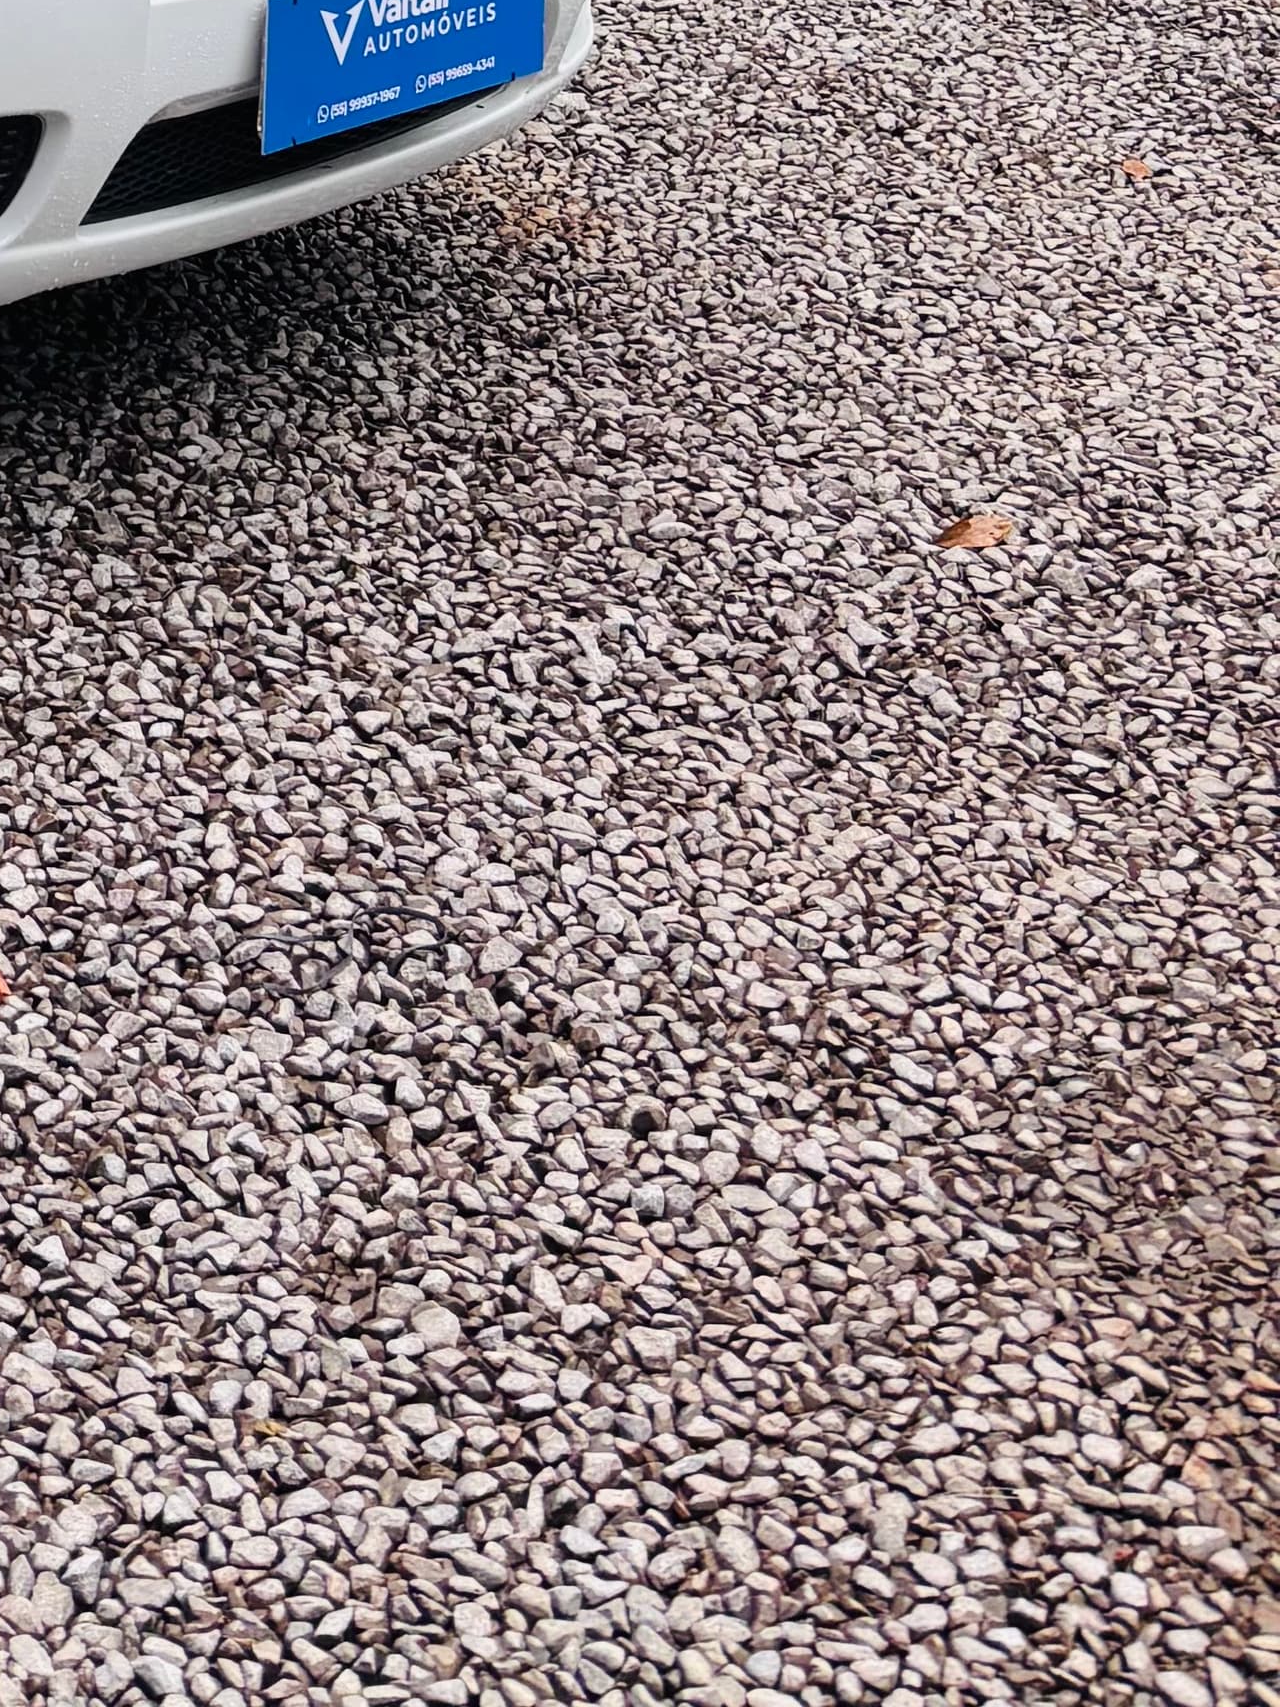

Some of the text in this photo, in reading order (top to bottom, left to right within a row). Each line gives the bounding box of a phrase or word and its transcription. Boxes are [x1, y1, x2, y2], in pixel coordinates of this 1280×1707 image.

[363, 2, 497, 58] AUTOMÓVEIS
[428, 69, 445, 88] (55)
[330, 86, 401, 120] (55) 99937-1967
